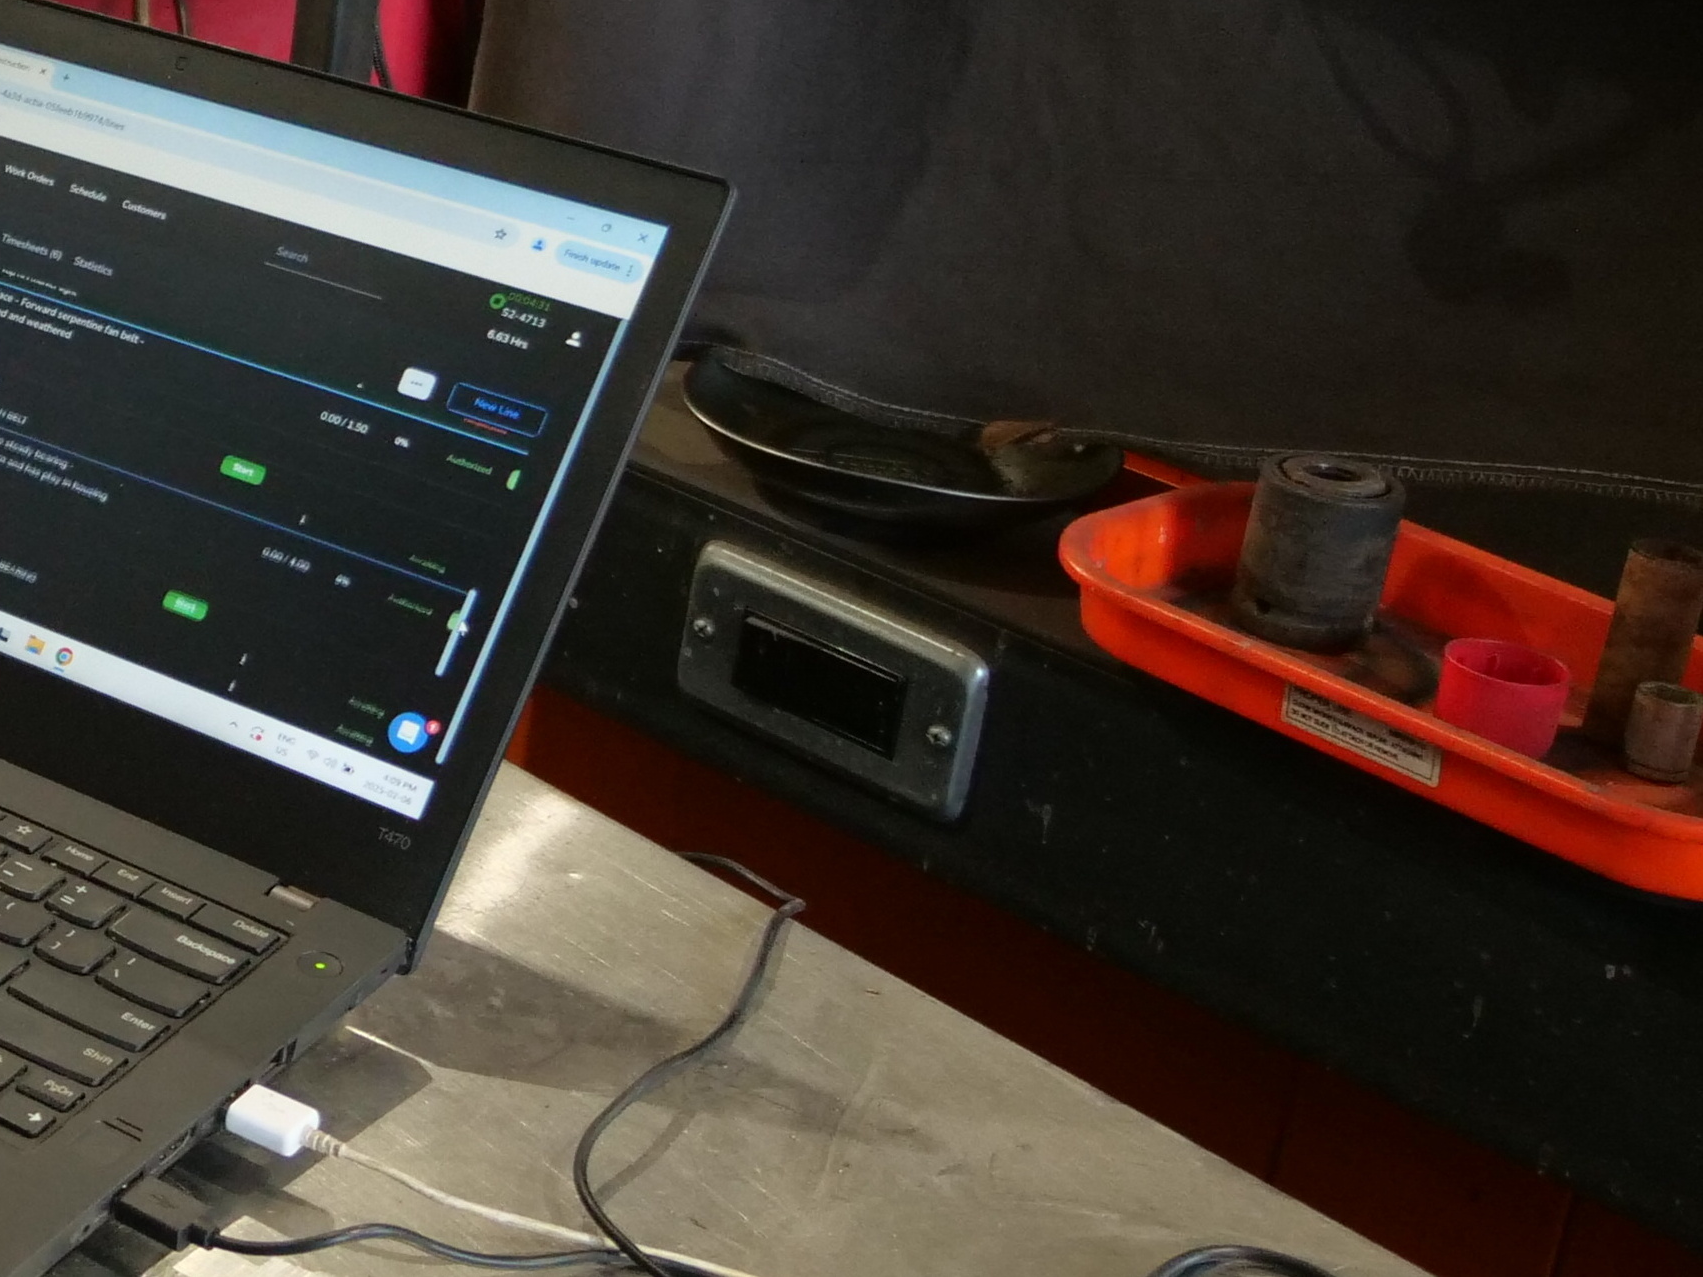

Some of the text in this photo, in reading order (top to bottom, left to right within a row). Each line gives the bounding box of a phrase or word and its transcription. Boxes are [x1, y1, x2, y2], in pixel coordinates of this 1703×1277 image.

[4, 164, 54, 186] Work Orders
[69, 183, 107, 202] Schedule
[121, 199, 166, 220] Customers
[1, 233, 48, 255] Timesheets
[73, 256, 113, 276] Statistics
[563, 248, 620, 271] Finish update
[7, 311, 26, 323] and
[25, 318, 72, 339] weathered
[20, 297, 57, 316] Forward
[57, 311, 103, 332] serpentine
[103, 325, 119, 337] fan
[119, 330, 139, 344] belt
[501, 307, 546, 328] S2-4713
[486, 329, 528, 349] 6.63 Hrs
[473, 397, 519, 419] New Line
[319, 410, 341, 425] 0.00
[346, 419, 368, 434] 1.50
[232, 462, 254, 476] Start
[378, 826, 411, 850] T470
[65, 845, 94, 861] Home
[117, 868, 139, 881] End
[161, 886, 193, 905] Insert
[232, 919, 269, 939] Delete
[176, 935, 236, 965] Backspace
[121, 1011, 155, 1031] Enter
[82, 1046, 116, 1068] Shift
